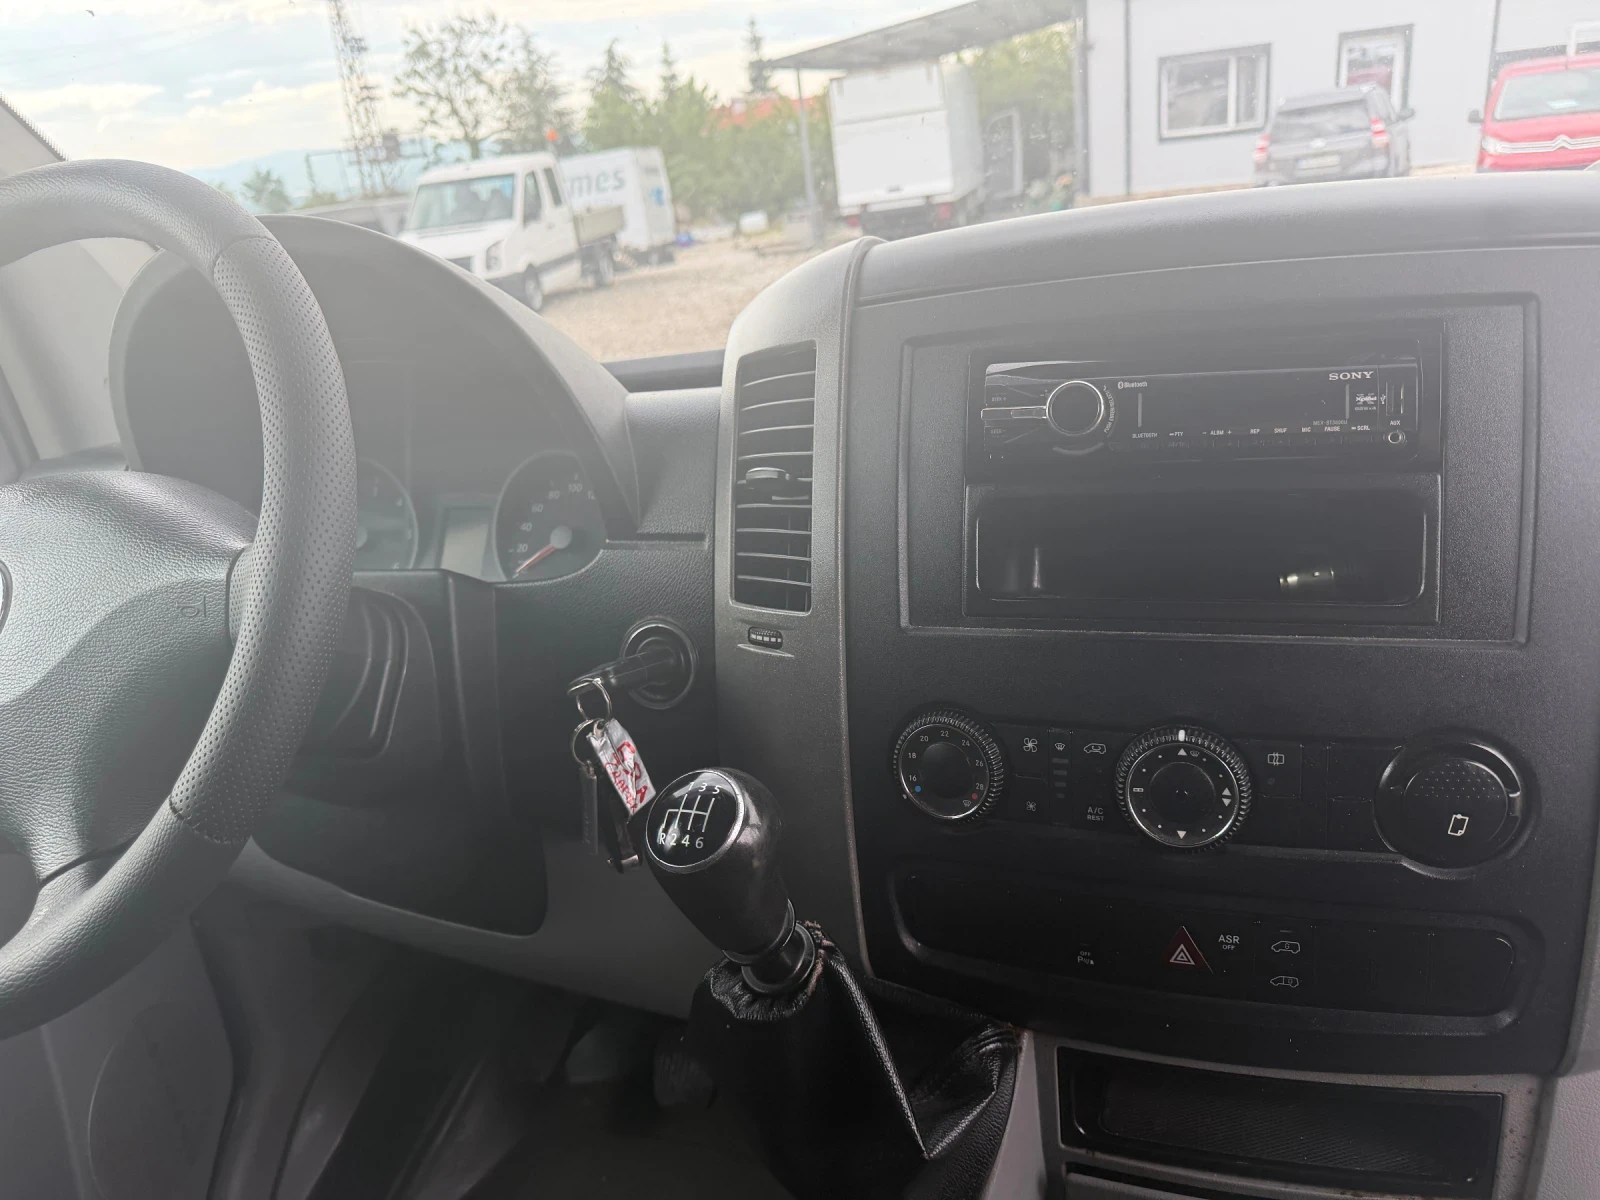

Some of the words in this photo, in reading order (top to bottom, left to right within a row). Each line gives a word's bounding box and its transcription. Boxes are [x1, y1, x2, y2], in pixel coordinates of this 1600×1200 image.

[1329, 371, 1374, 381] SONY
[547, 490, 560, 500] 80
[531, 503, 544, 513] 60
[520, 522, 533, 532] 40
[516, 543, 528, 553] 20
[961, 739, 970, 747] 24
[975, 759, 984, 767] 26
[908, 774, 917, 782] 16
[688, 782, 695, 790] 1
[698, 782, 707, 792] 3
[712, 784, 721, 794] 5
[975, 782, 984, 790] 28
[1087, 806, 1104, 815] A/C
[658, 832, 666, 845] R
[669, 833, 677, 846] 2
[681, 834, 690, 847] 4
[695, 836, 704, 849] 6
[1218, 934, 1240, 944] ASR
